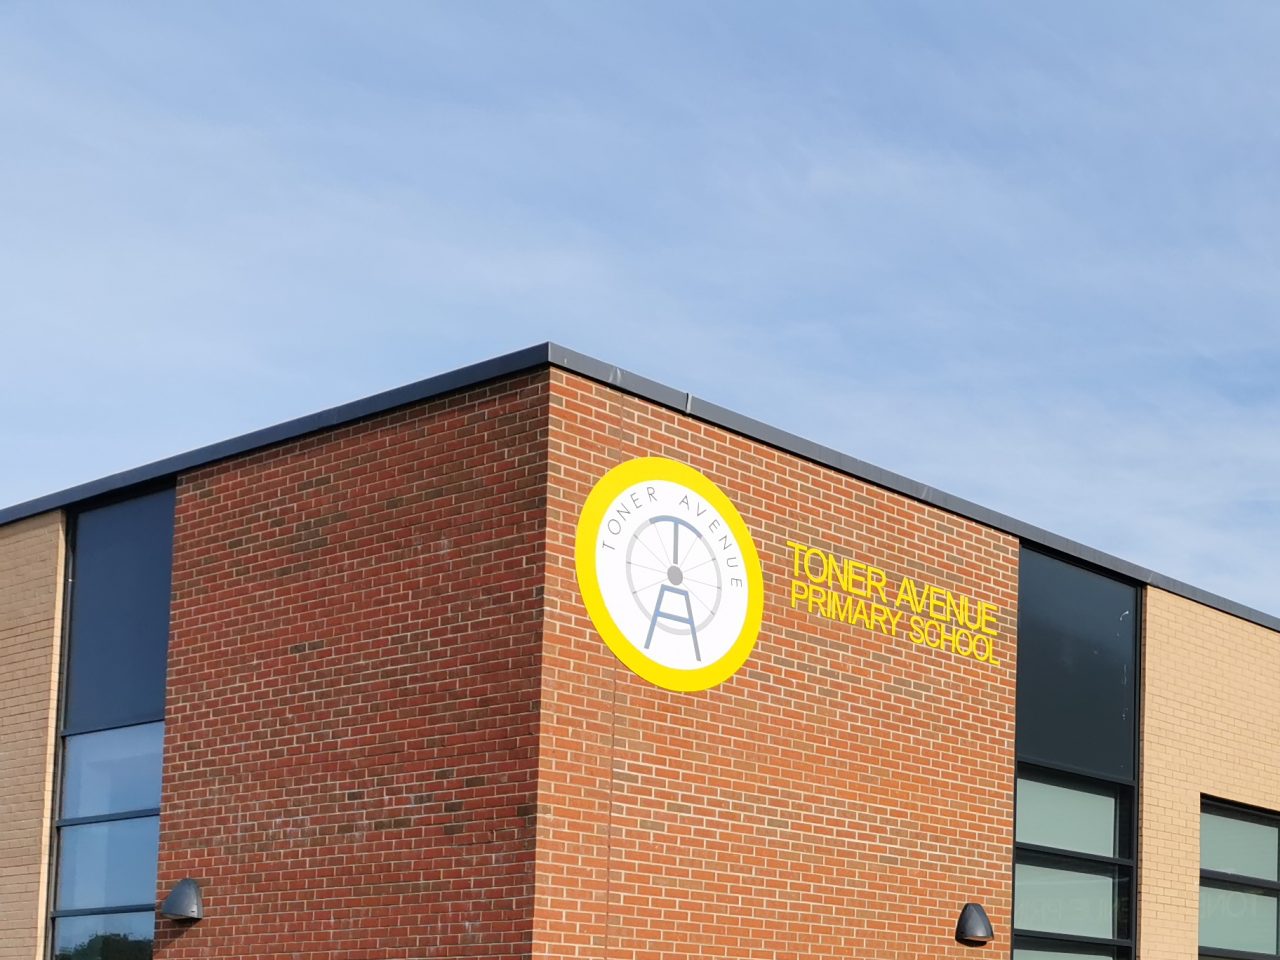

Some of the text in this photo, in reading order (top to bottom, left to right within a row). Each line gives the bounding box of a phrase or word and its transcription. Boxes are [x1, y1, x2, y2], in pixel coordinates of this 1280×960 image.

[602, 486, 743, 588] TONER AVENUE
[786, 540, 999, 636] TONER AVENUE
[790, 580, 1001, 666] PRIMARY SCHOOL
